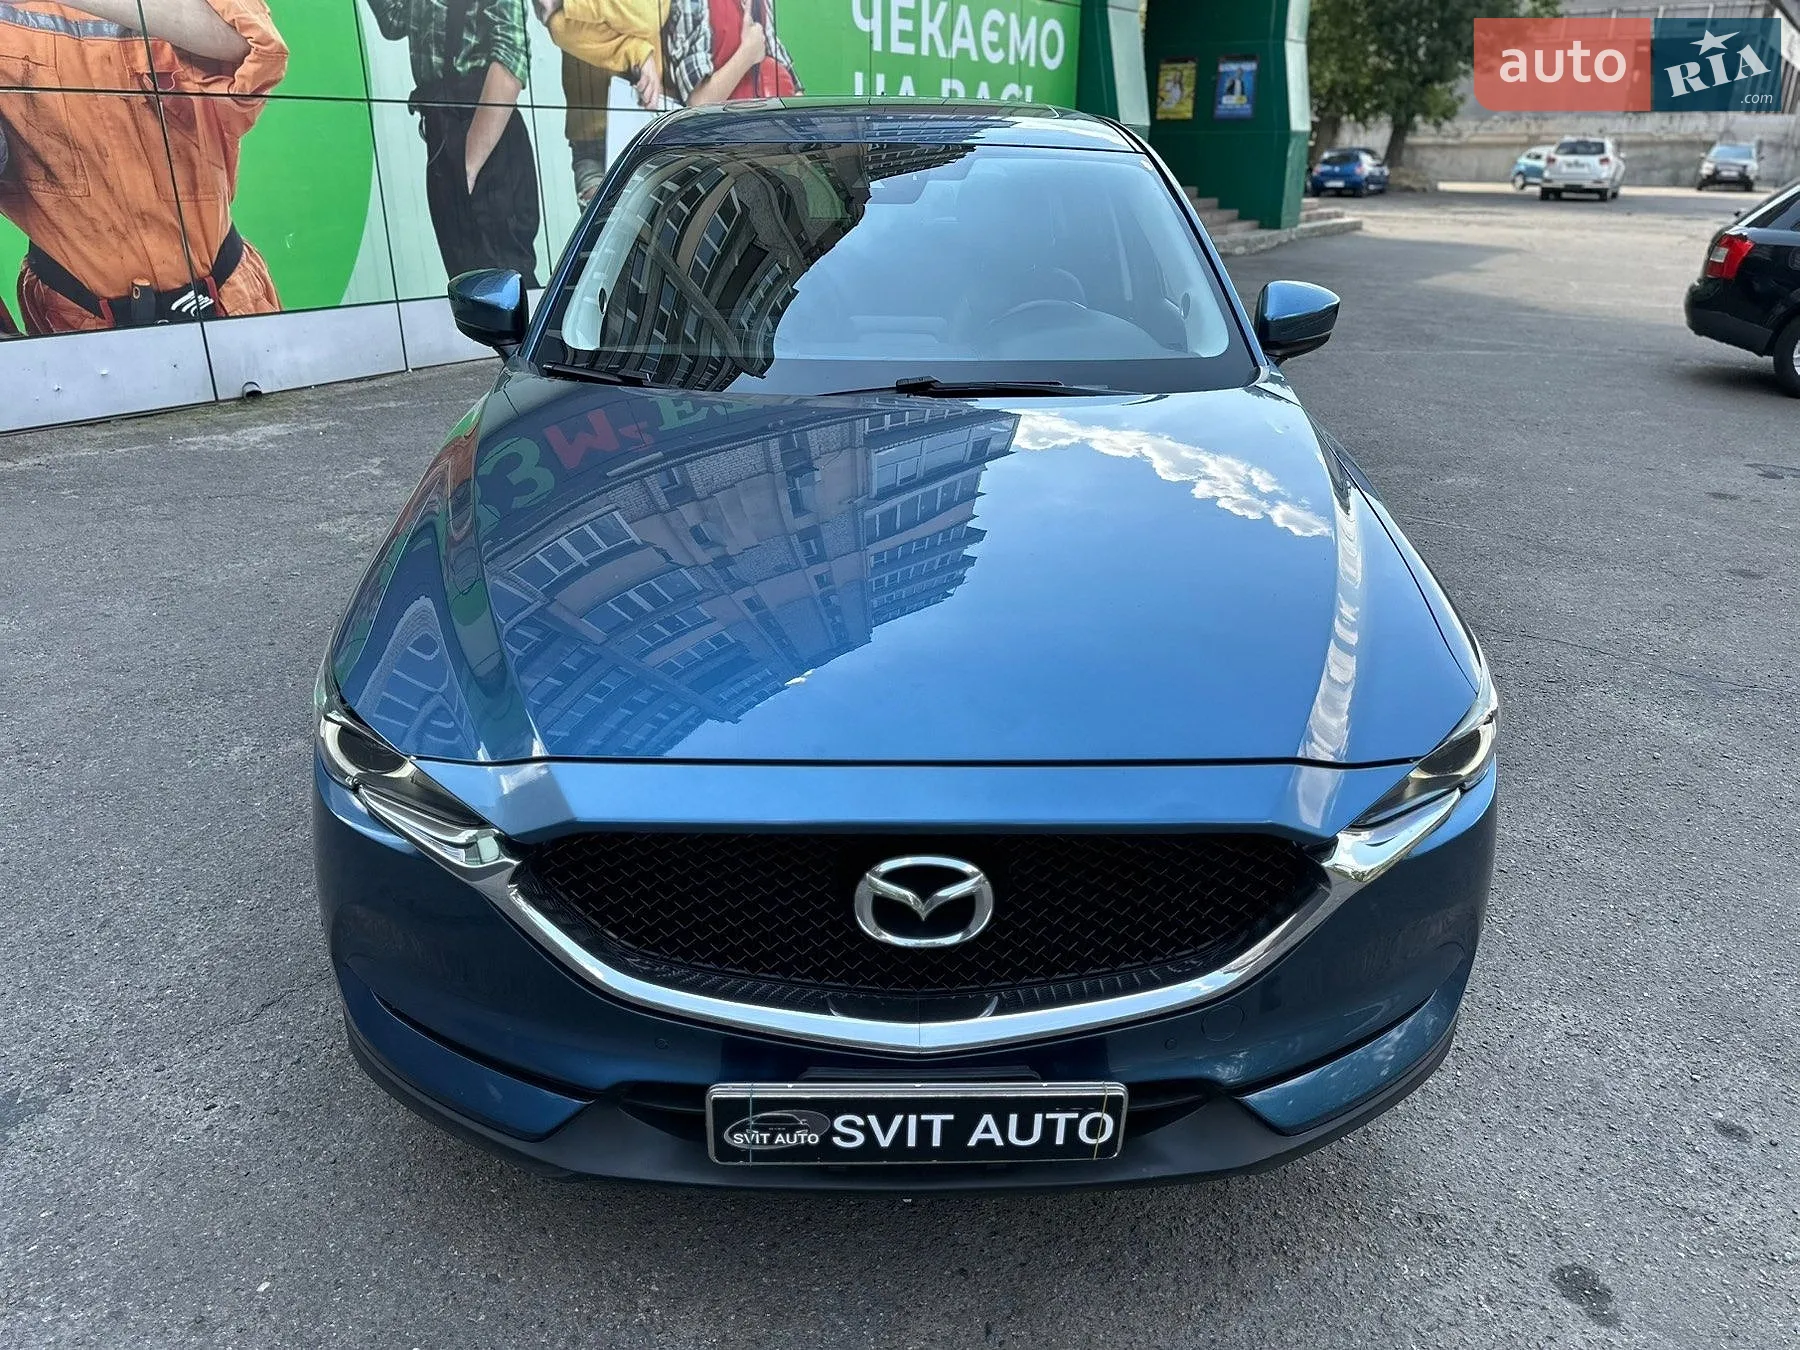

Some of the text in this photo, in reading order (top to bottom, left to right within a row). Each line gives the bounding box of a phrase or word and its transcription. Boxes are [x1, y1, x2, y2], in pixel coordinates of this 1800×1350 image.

[852, 0, 1065, 71] ЧЕКАЄМО
[733, 1133, 820, 1145] SVIT AUTO
[832, 1112, 1114, 1148] SVIT AUTO
